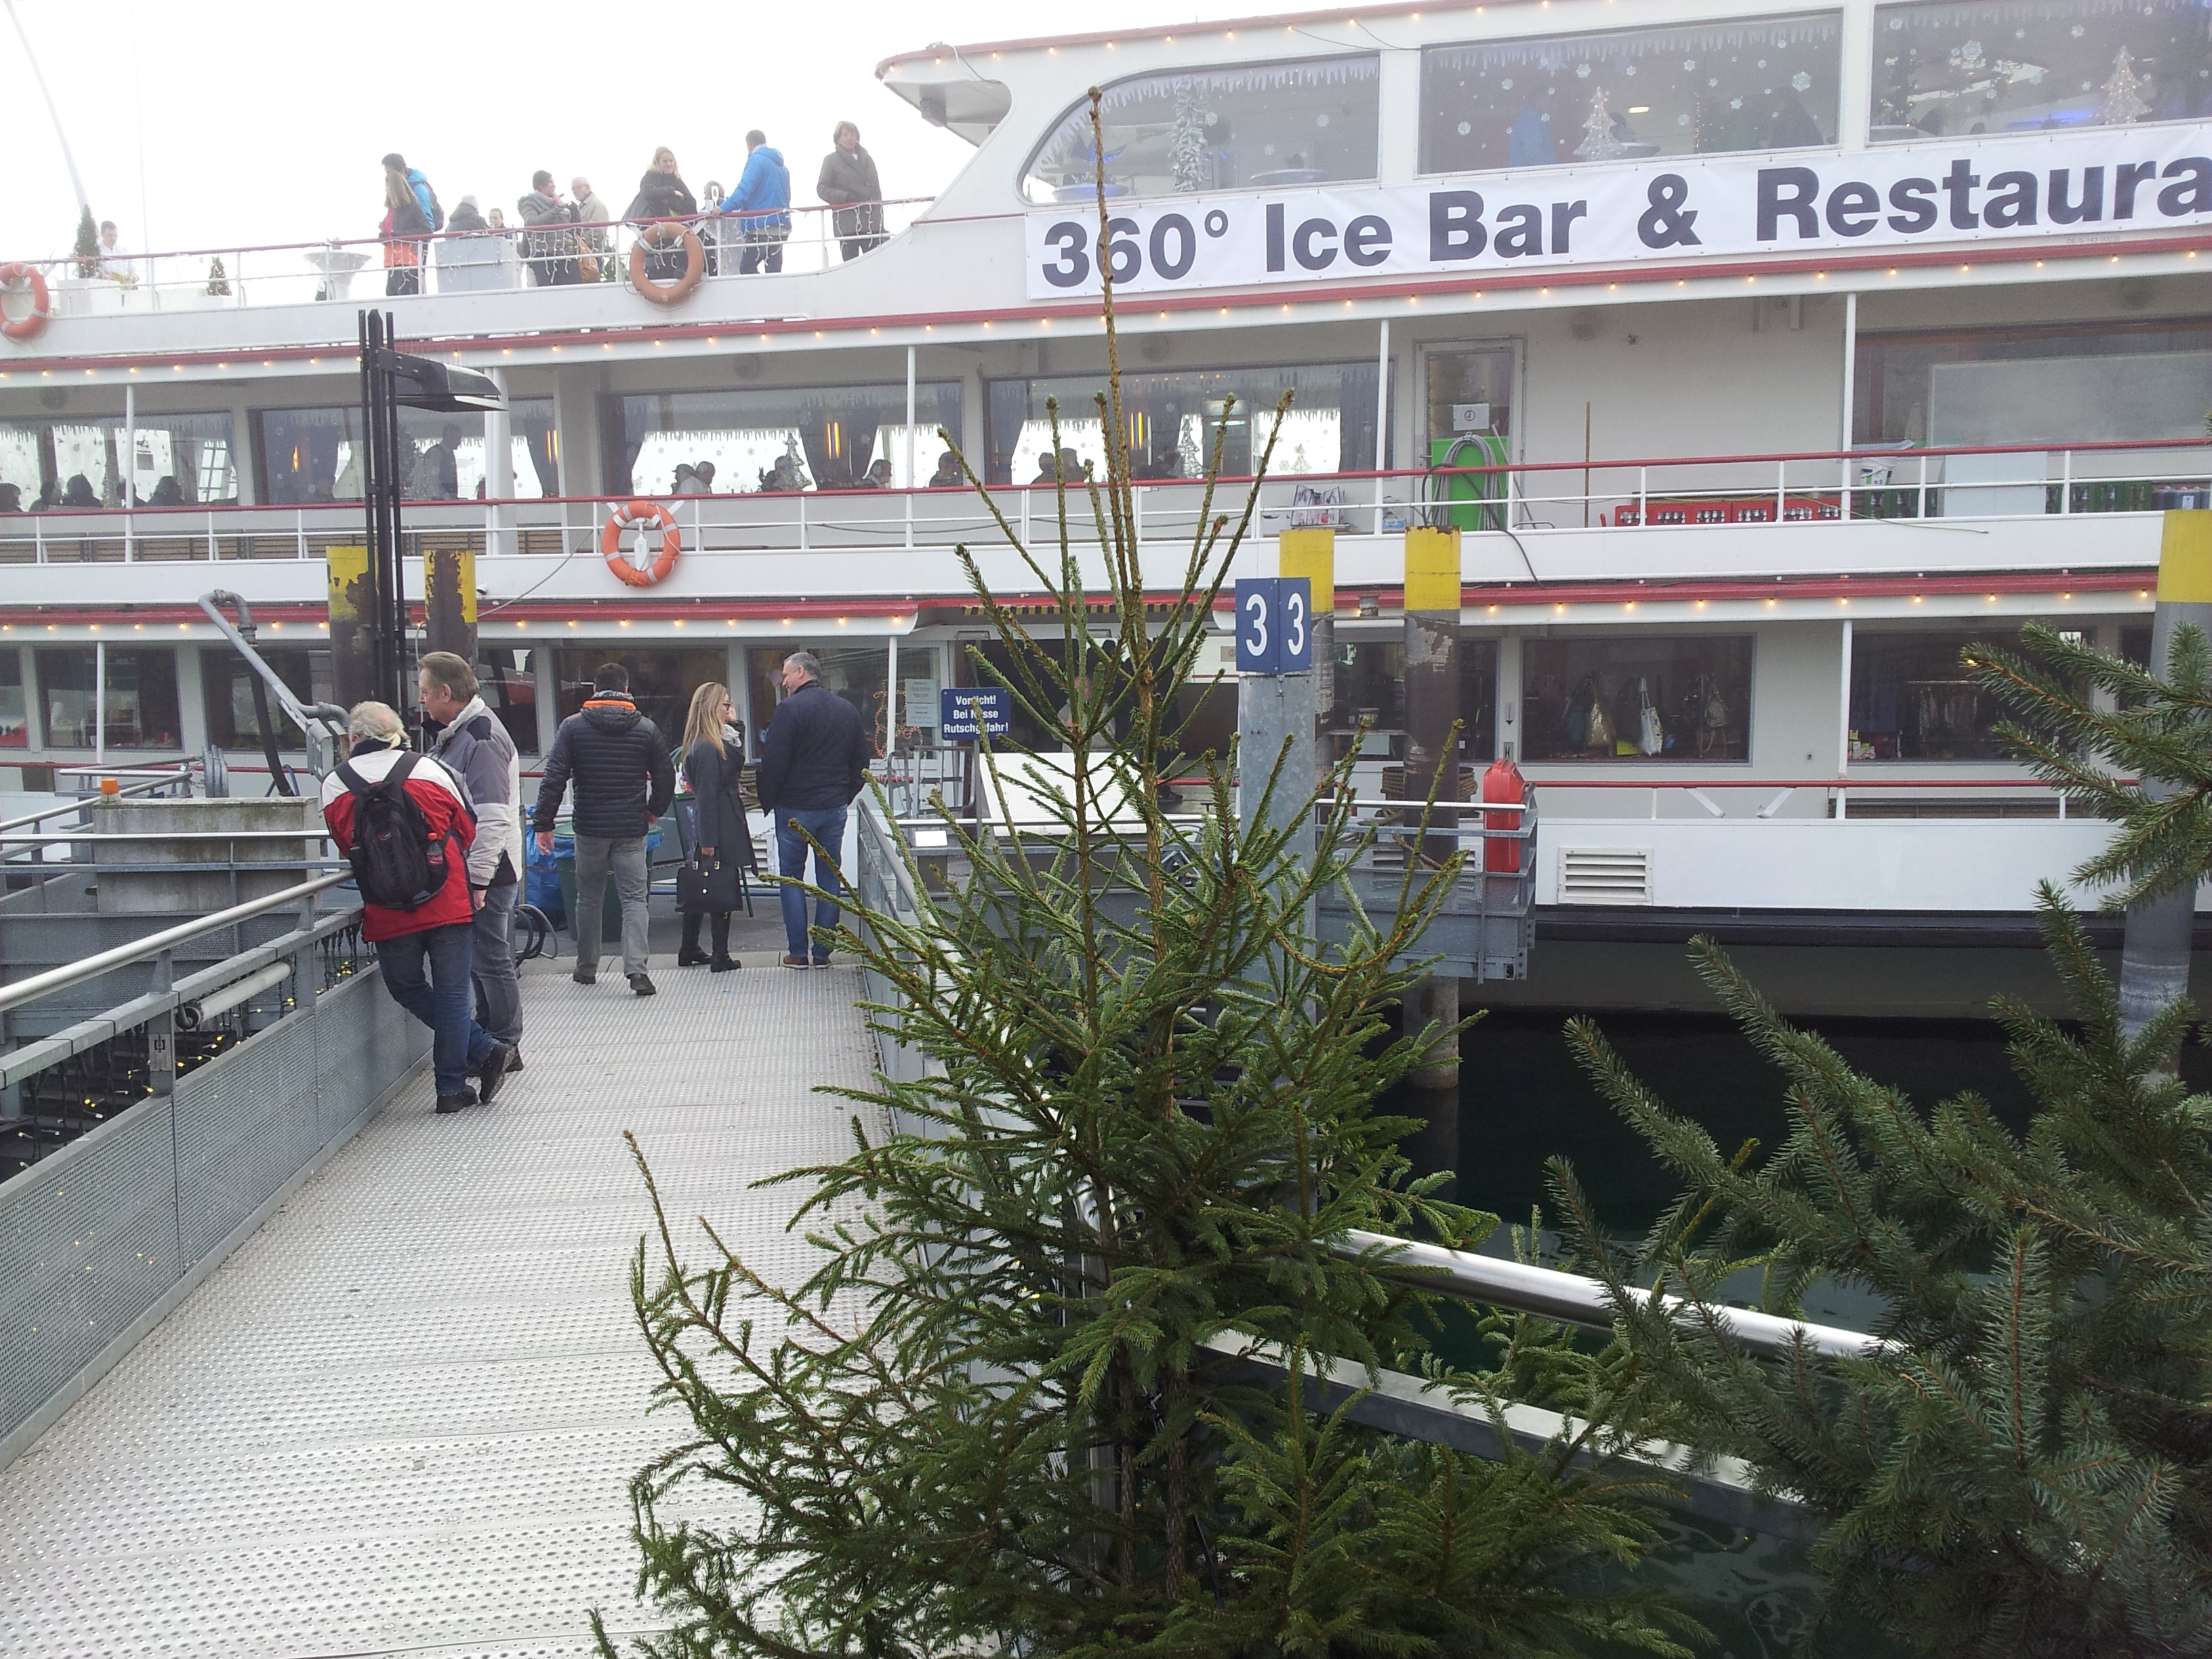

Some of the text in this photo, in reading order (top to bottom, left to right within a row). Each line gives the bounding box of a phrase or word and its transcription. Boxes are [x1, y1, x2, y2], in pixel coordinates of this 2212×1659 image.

[1266, 203, 1393, 272] Ice
[1429, 190, 1587, 262] Bar
[1637, 173, 1702, 249] &
[1757, 157, 2212, 241] Restaura
[1246, 594, 1267, 656] 3
[1288, 592, 1304, 656] 3
[943, 722, 1009, 735] Rutschgfahr!
[953, 709, 999, 719] Bei Nsse
